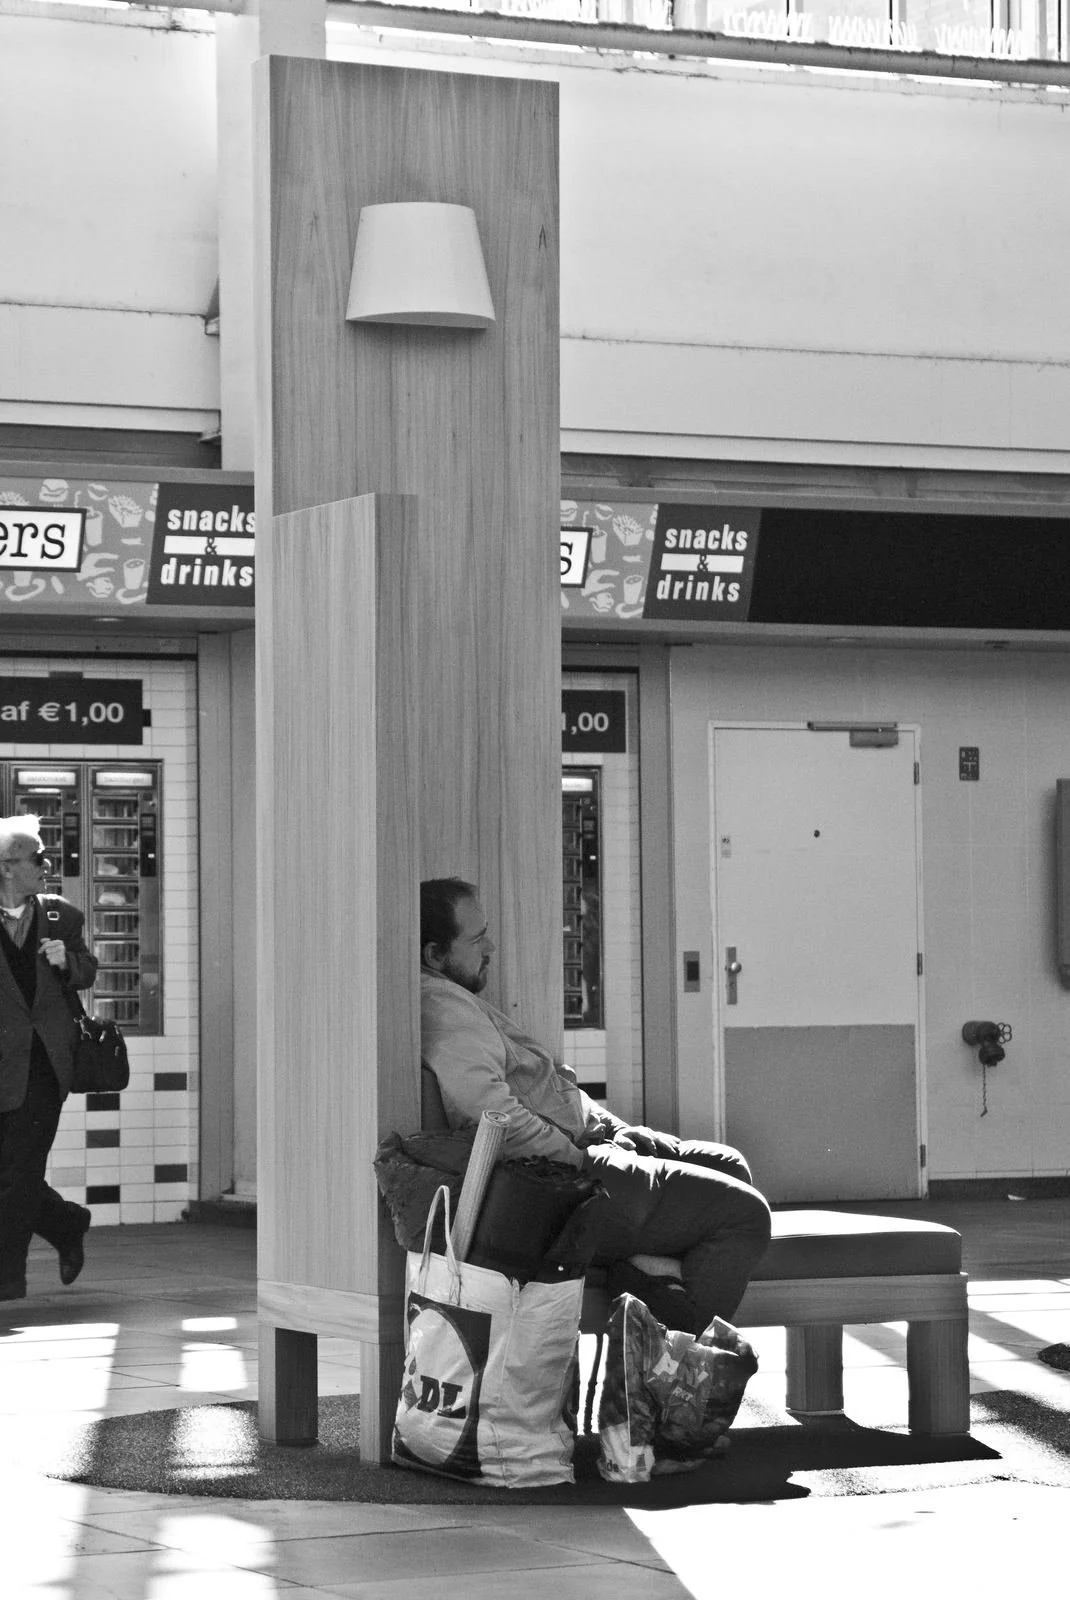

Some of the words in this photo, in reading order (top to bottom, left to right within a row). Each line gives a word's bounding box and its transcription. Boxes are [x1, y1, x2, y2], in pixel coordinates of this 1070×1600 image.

[167, 505, 255, 533] snacks
[204, 537, 218, 556] &
[664, 524, 748, 551] snacks
[160, 557, 254, 587] drinks
[697, 554, 709, 572] &
[656, 573, 741, 603] drinks
[0, 701, 30, 722] af
